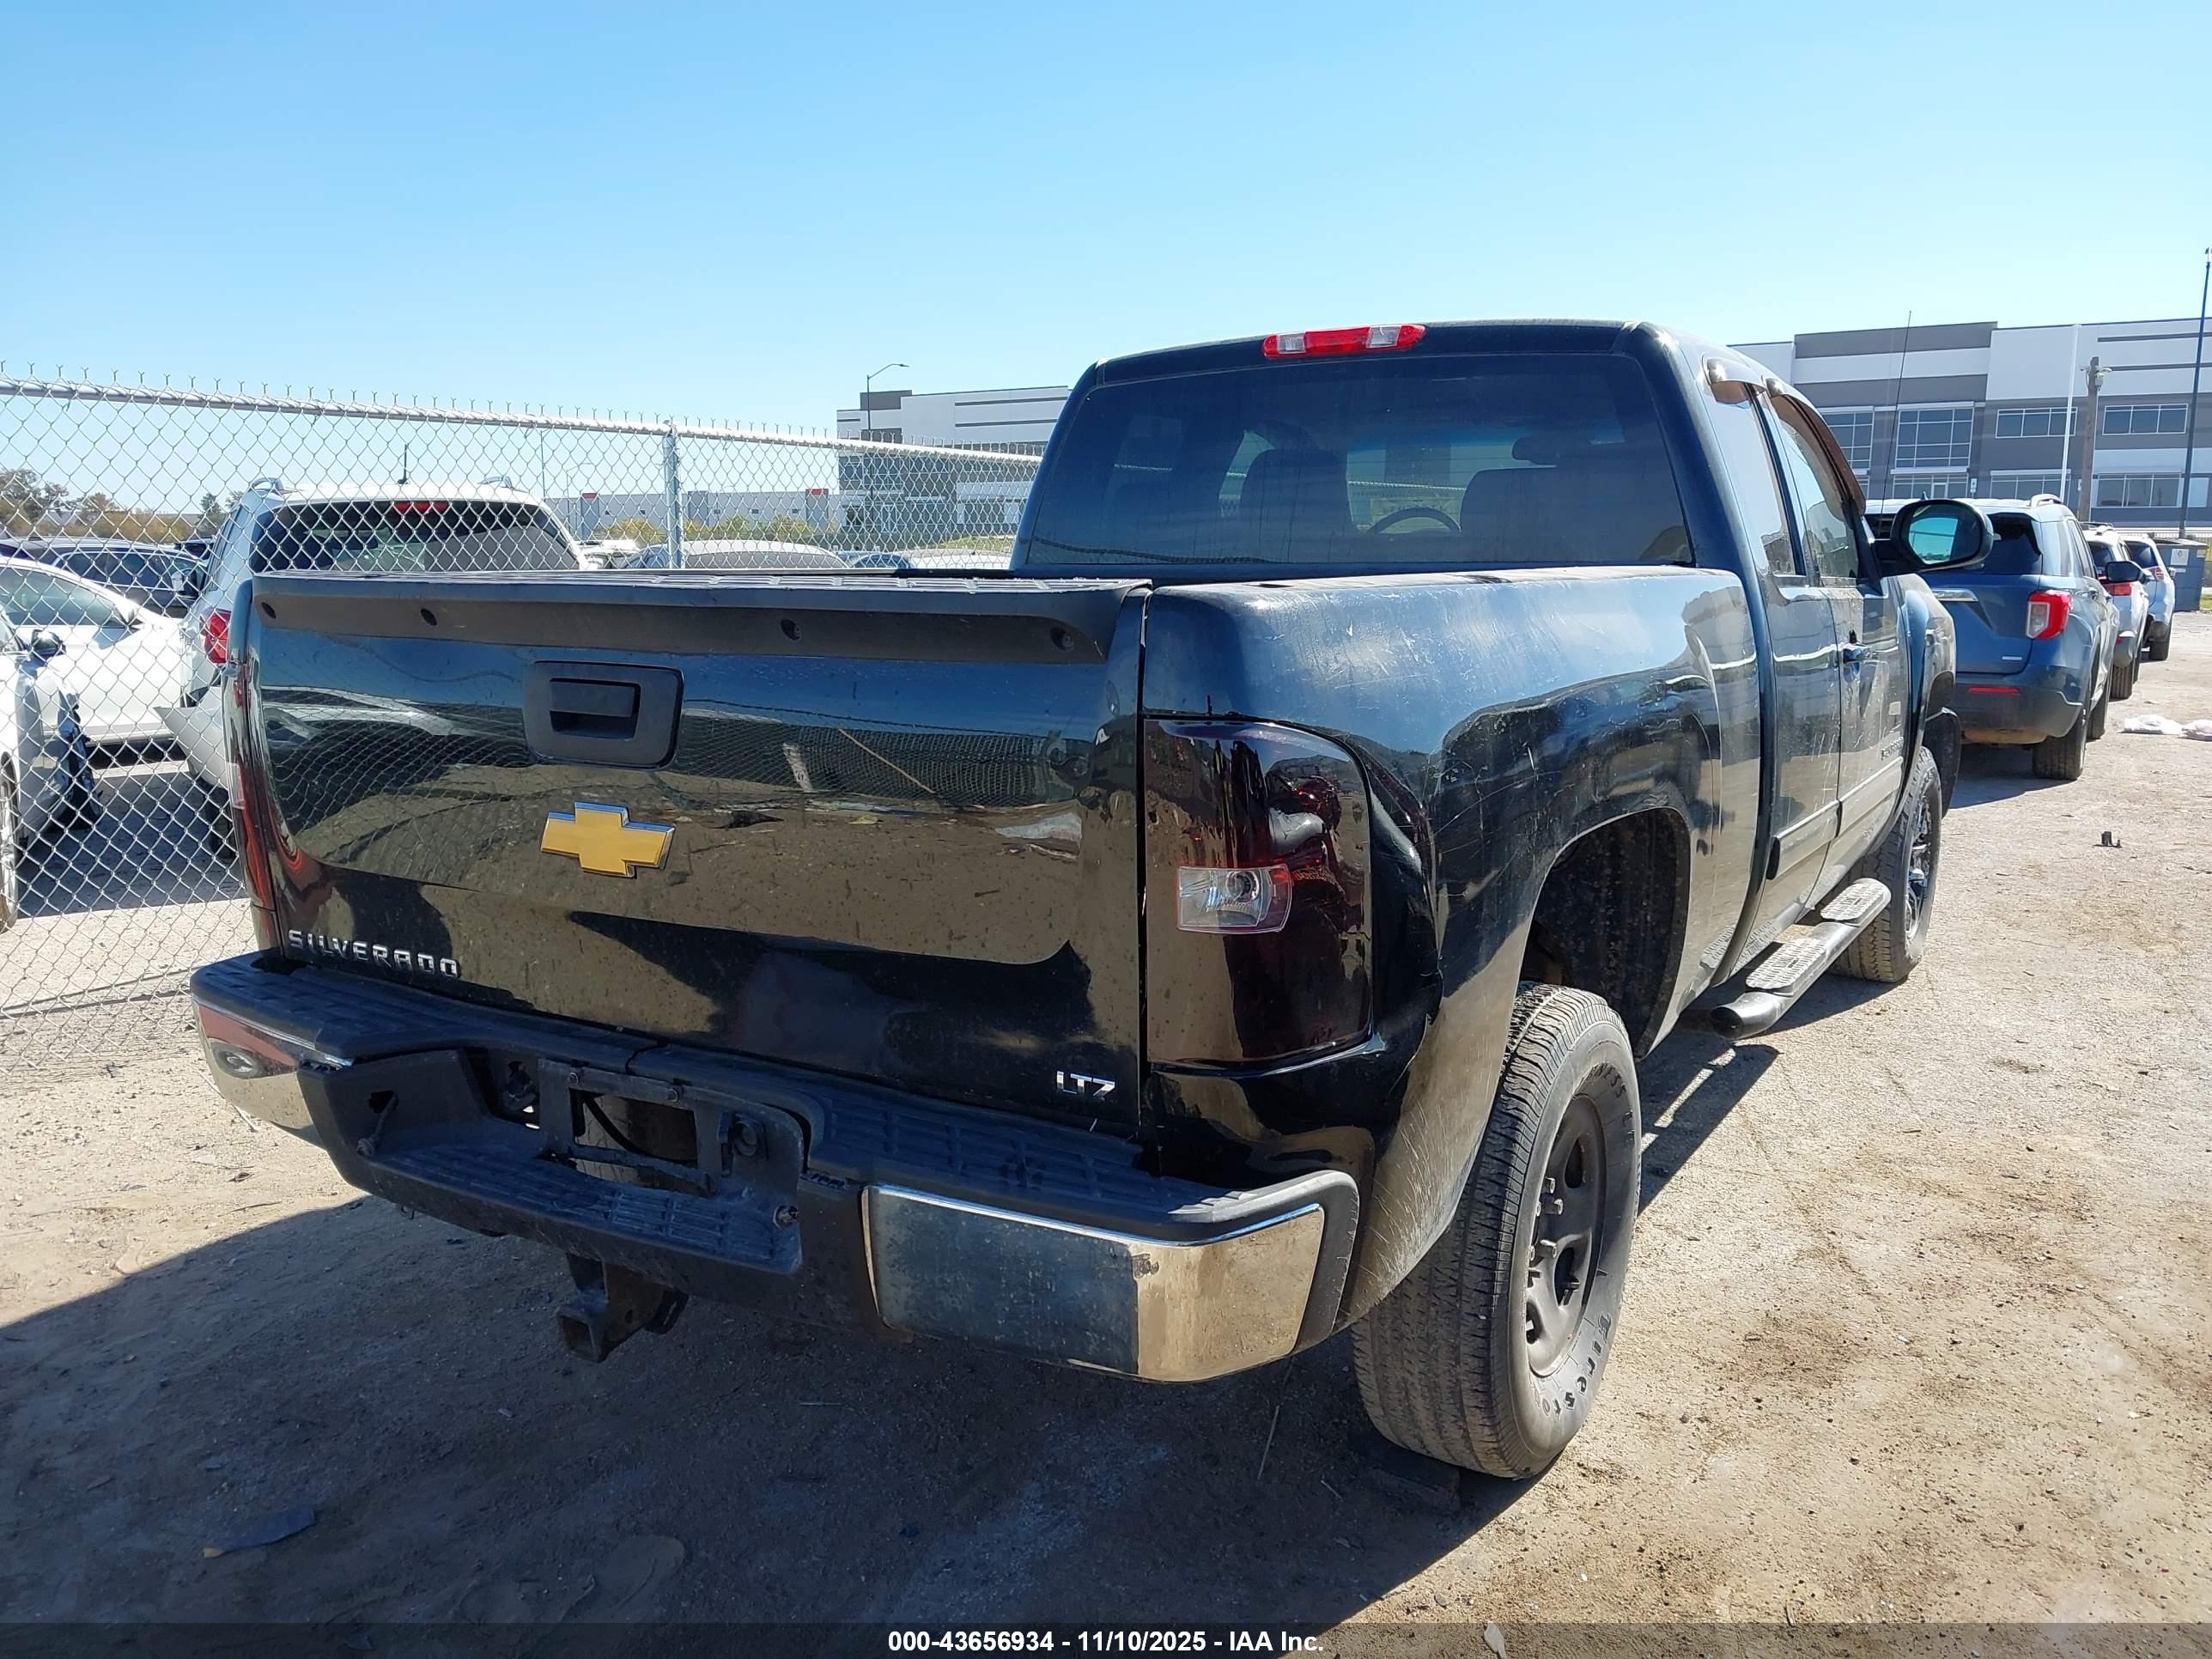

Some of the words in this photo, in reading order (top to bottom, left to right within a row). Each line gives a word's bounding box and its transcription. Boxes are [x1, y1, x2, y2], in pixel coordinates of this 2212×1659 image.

[289, 929, 459, 977] SILVERADO
[1056, 1070, 1115, 1099] LTZ
[1531, 1313, 1612, 1421] Firesto
